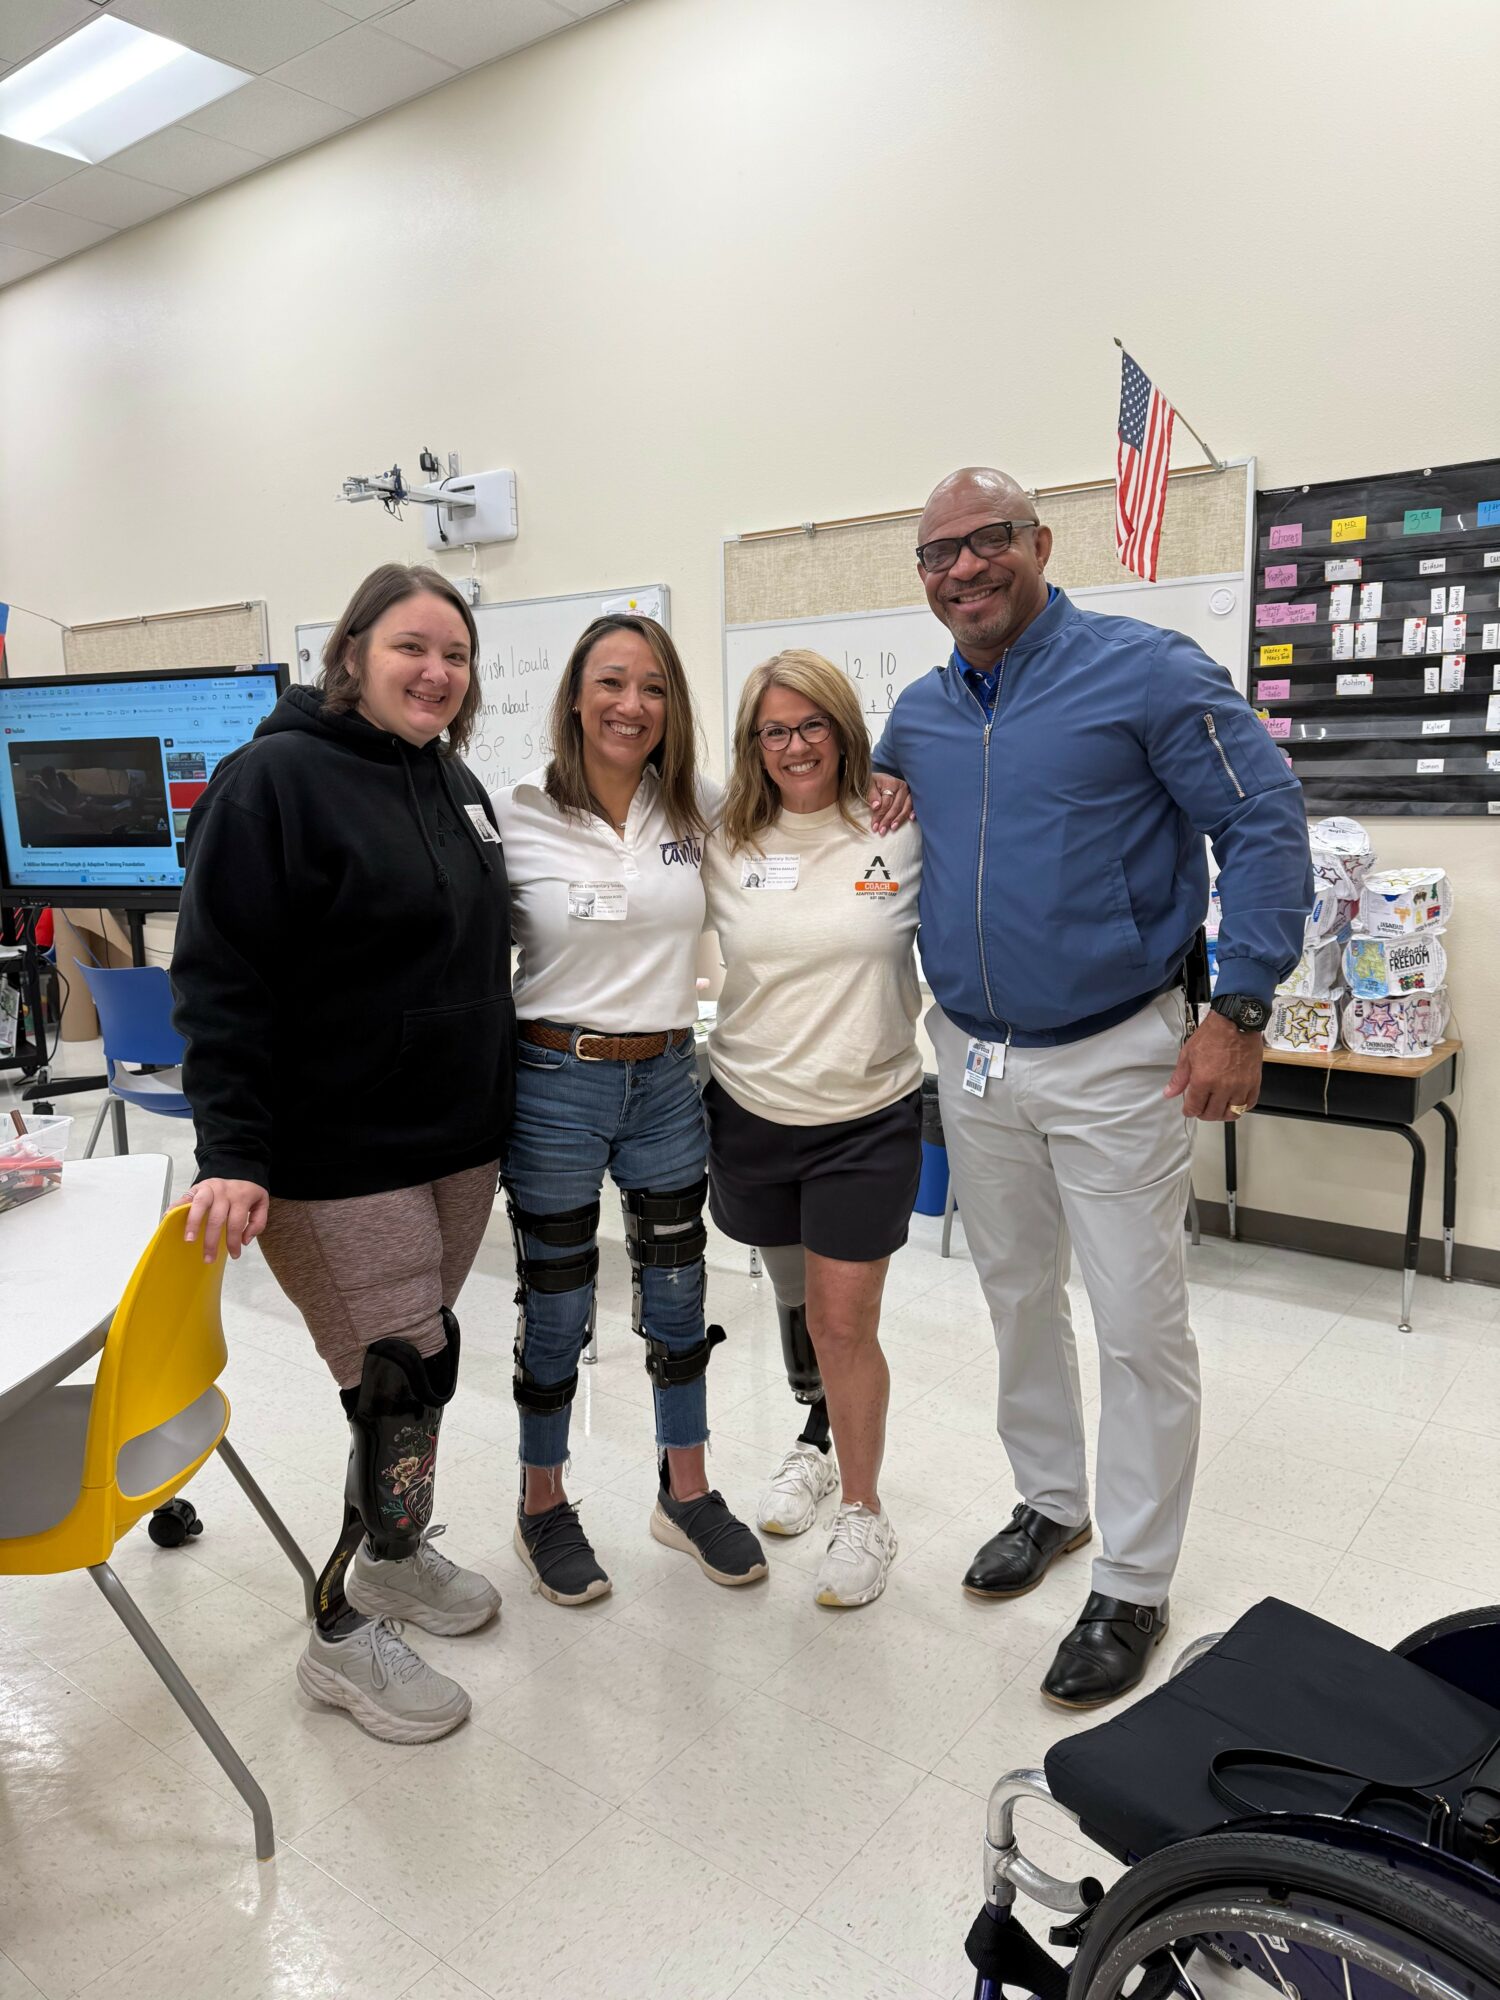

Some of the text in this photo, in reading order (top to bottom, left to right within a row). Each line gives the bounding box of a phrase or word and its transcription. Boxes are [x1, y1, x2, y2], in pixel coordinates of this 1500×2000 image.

[518, 647, 551, 676] could
[880, 651, 897, 679] 10
[886, 683, 896, 710] 8
[475, 733, 505, 762] Be
[864, 882, 890, 891] COACH
[1389, 951, 1430, 972] FREEDOM
